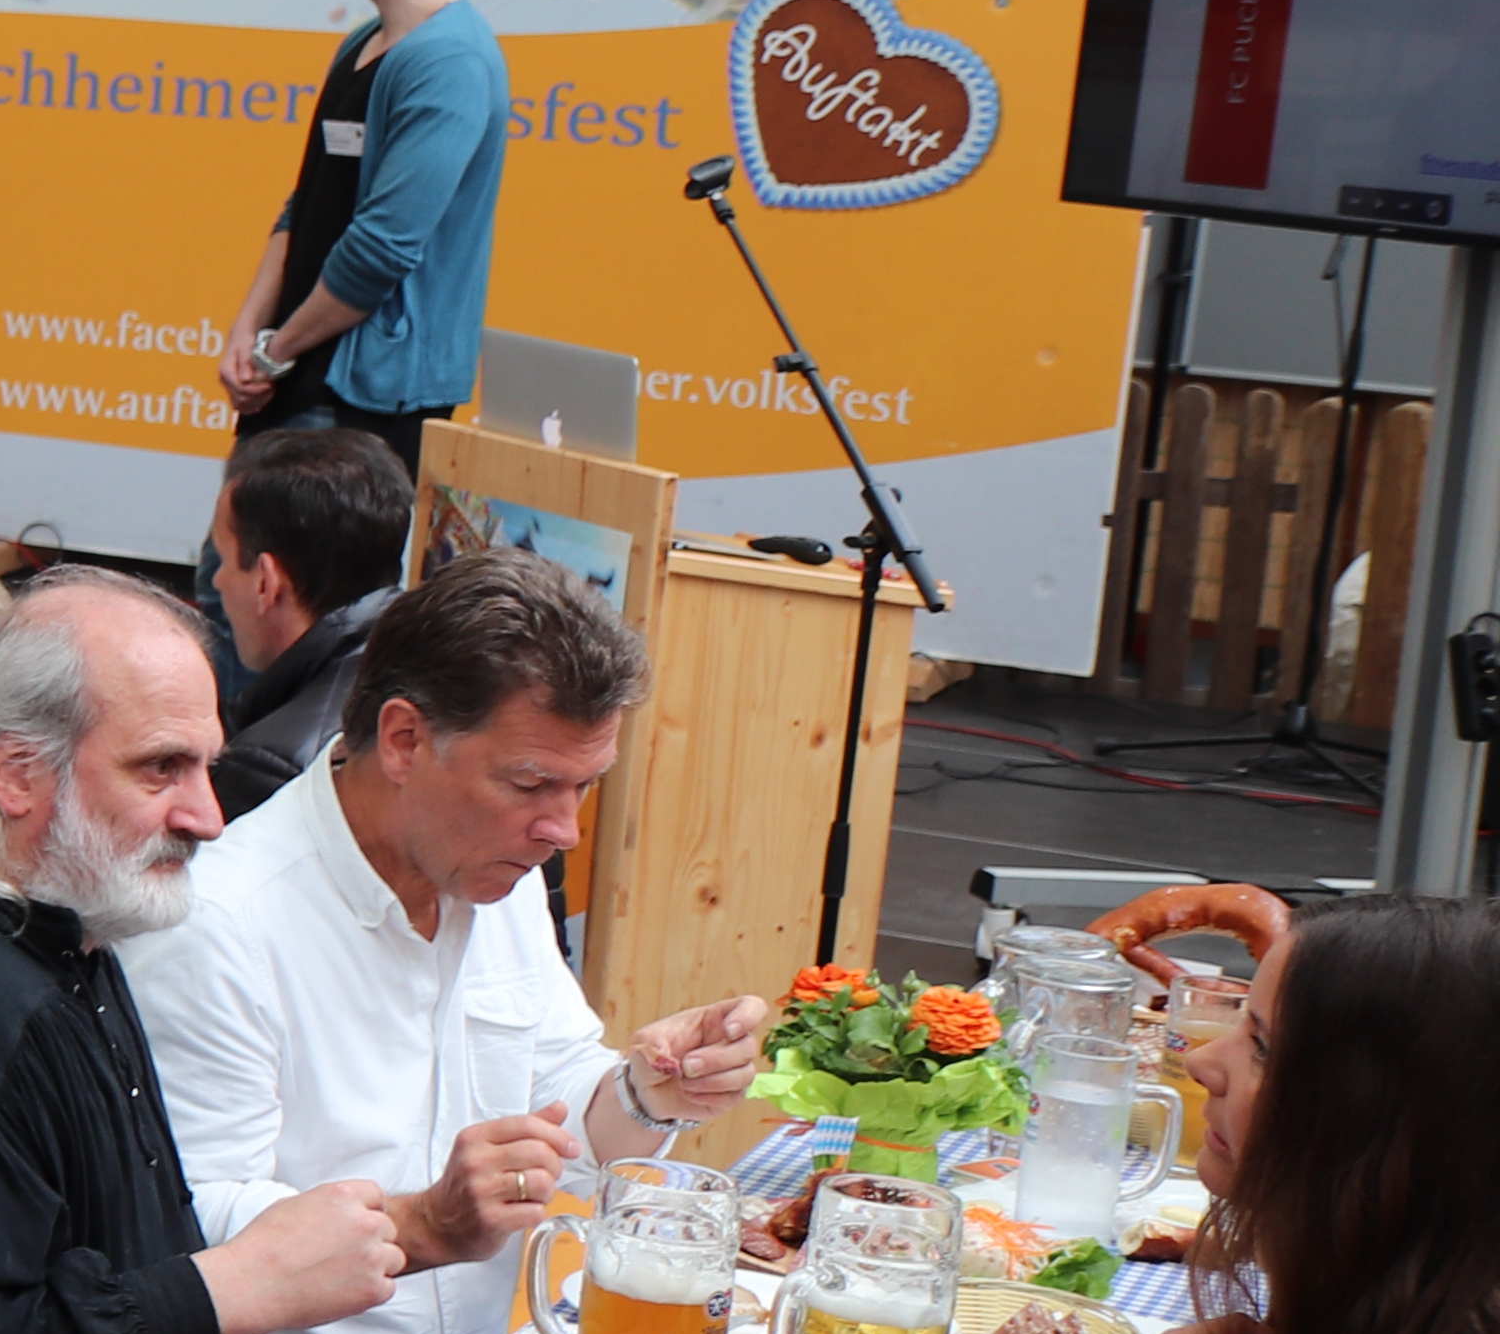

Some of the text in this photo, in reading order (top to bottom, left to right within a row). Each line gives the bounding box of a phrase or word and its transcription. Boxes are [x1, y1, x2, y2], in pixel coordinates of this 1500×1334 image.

[503, 81, 684, 150] sfest
[760, 23, 943, 166] Auftakt
[3, 310, 914, 426] www.faceb er.volksfest
